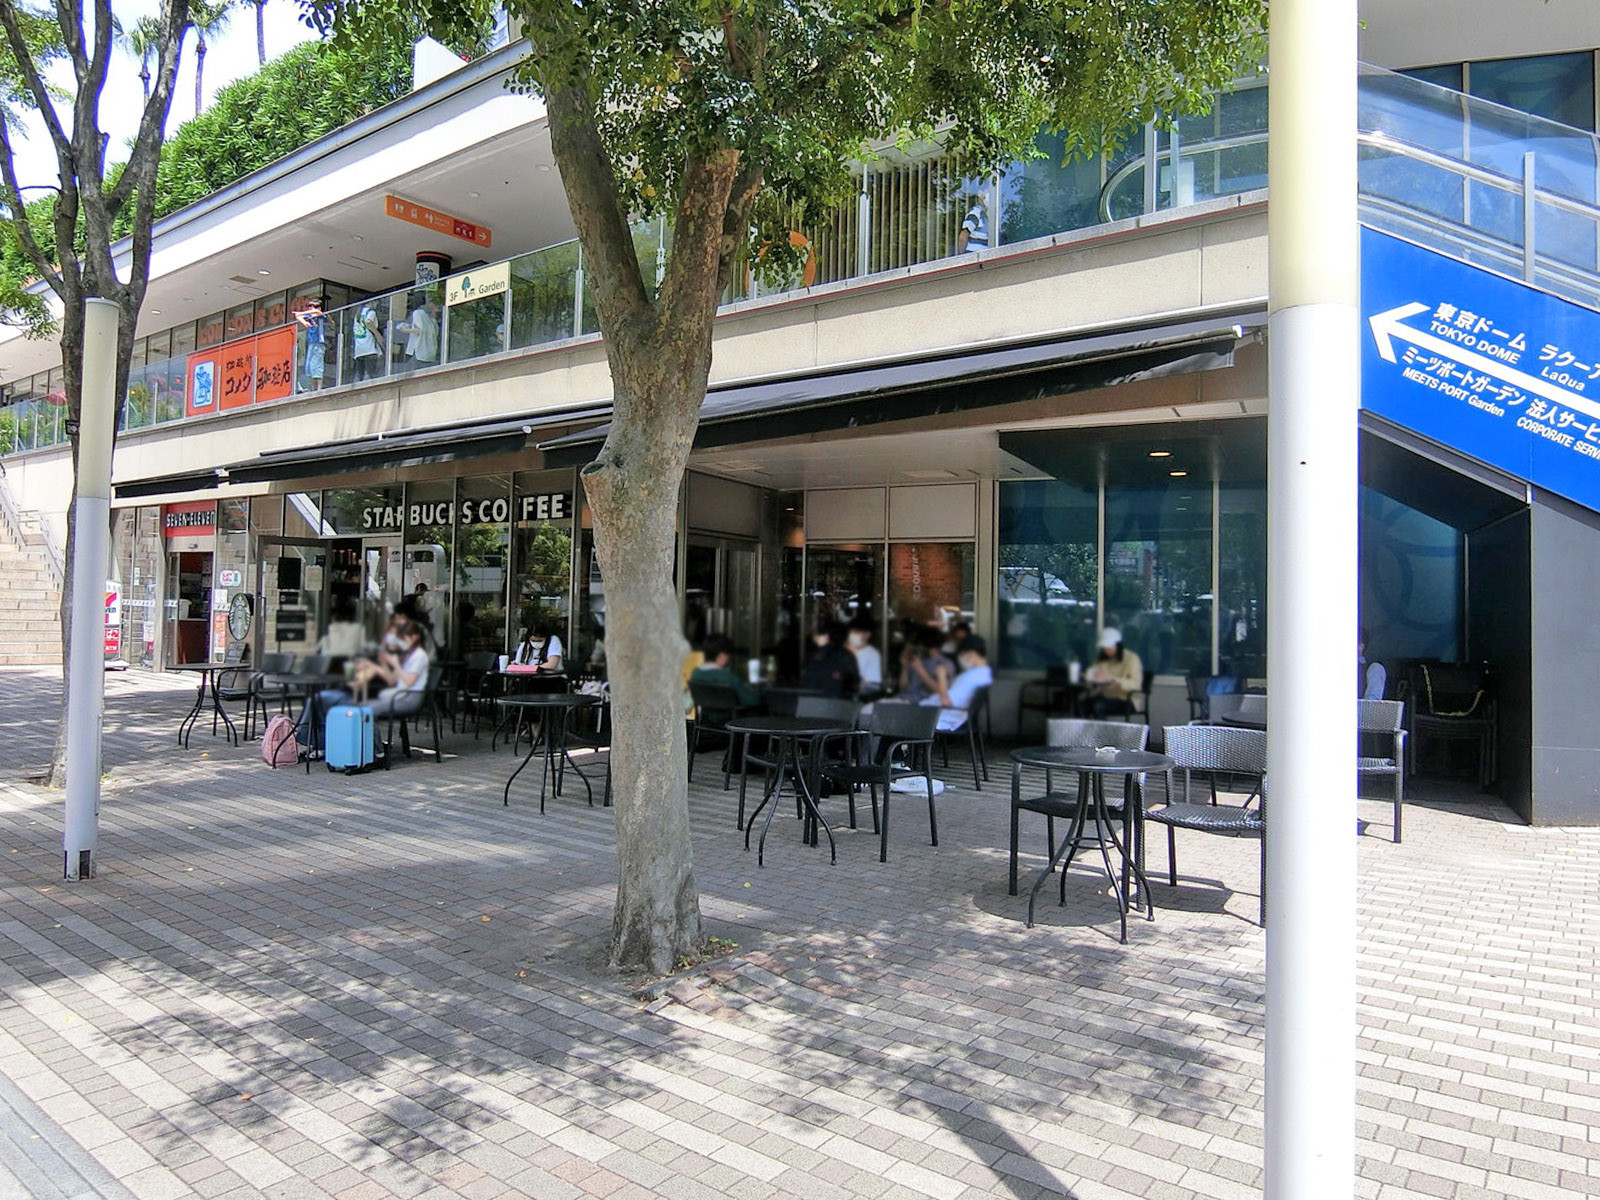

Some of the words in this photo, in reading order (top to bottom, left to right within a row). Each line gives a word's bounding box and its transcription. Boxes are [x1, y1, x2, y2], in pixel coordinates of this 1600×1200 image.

[478, 281, 505, 294] Garden
[1430, 320, 1477, 347] TOKYO
[1476, 339, 1521, 365] DOME
[1433, 302, 1526, 352] 東京ドーム
[1401, 346, 1527, 406] ミーツポートガーデン
[1525, 398, 1600, 443] 法人サービ
[1403, 366, 1440, 389] MEETS
[1437, 381, 1470, 401] PORT
[1467, 394, 1505, 417] Garden
[1541, 367, 1586, 391] LaQua
[1516, 416, 1575, 448] CORPORATE
[478, 494, 564, 523] COFEE
